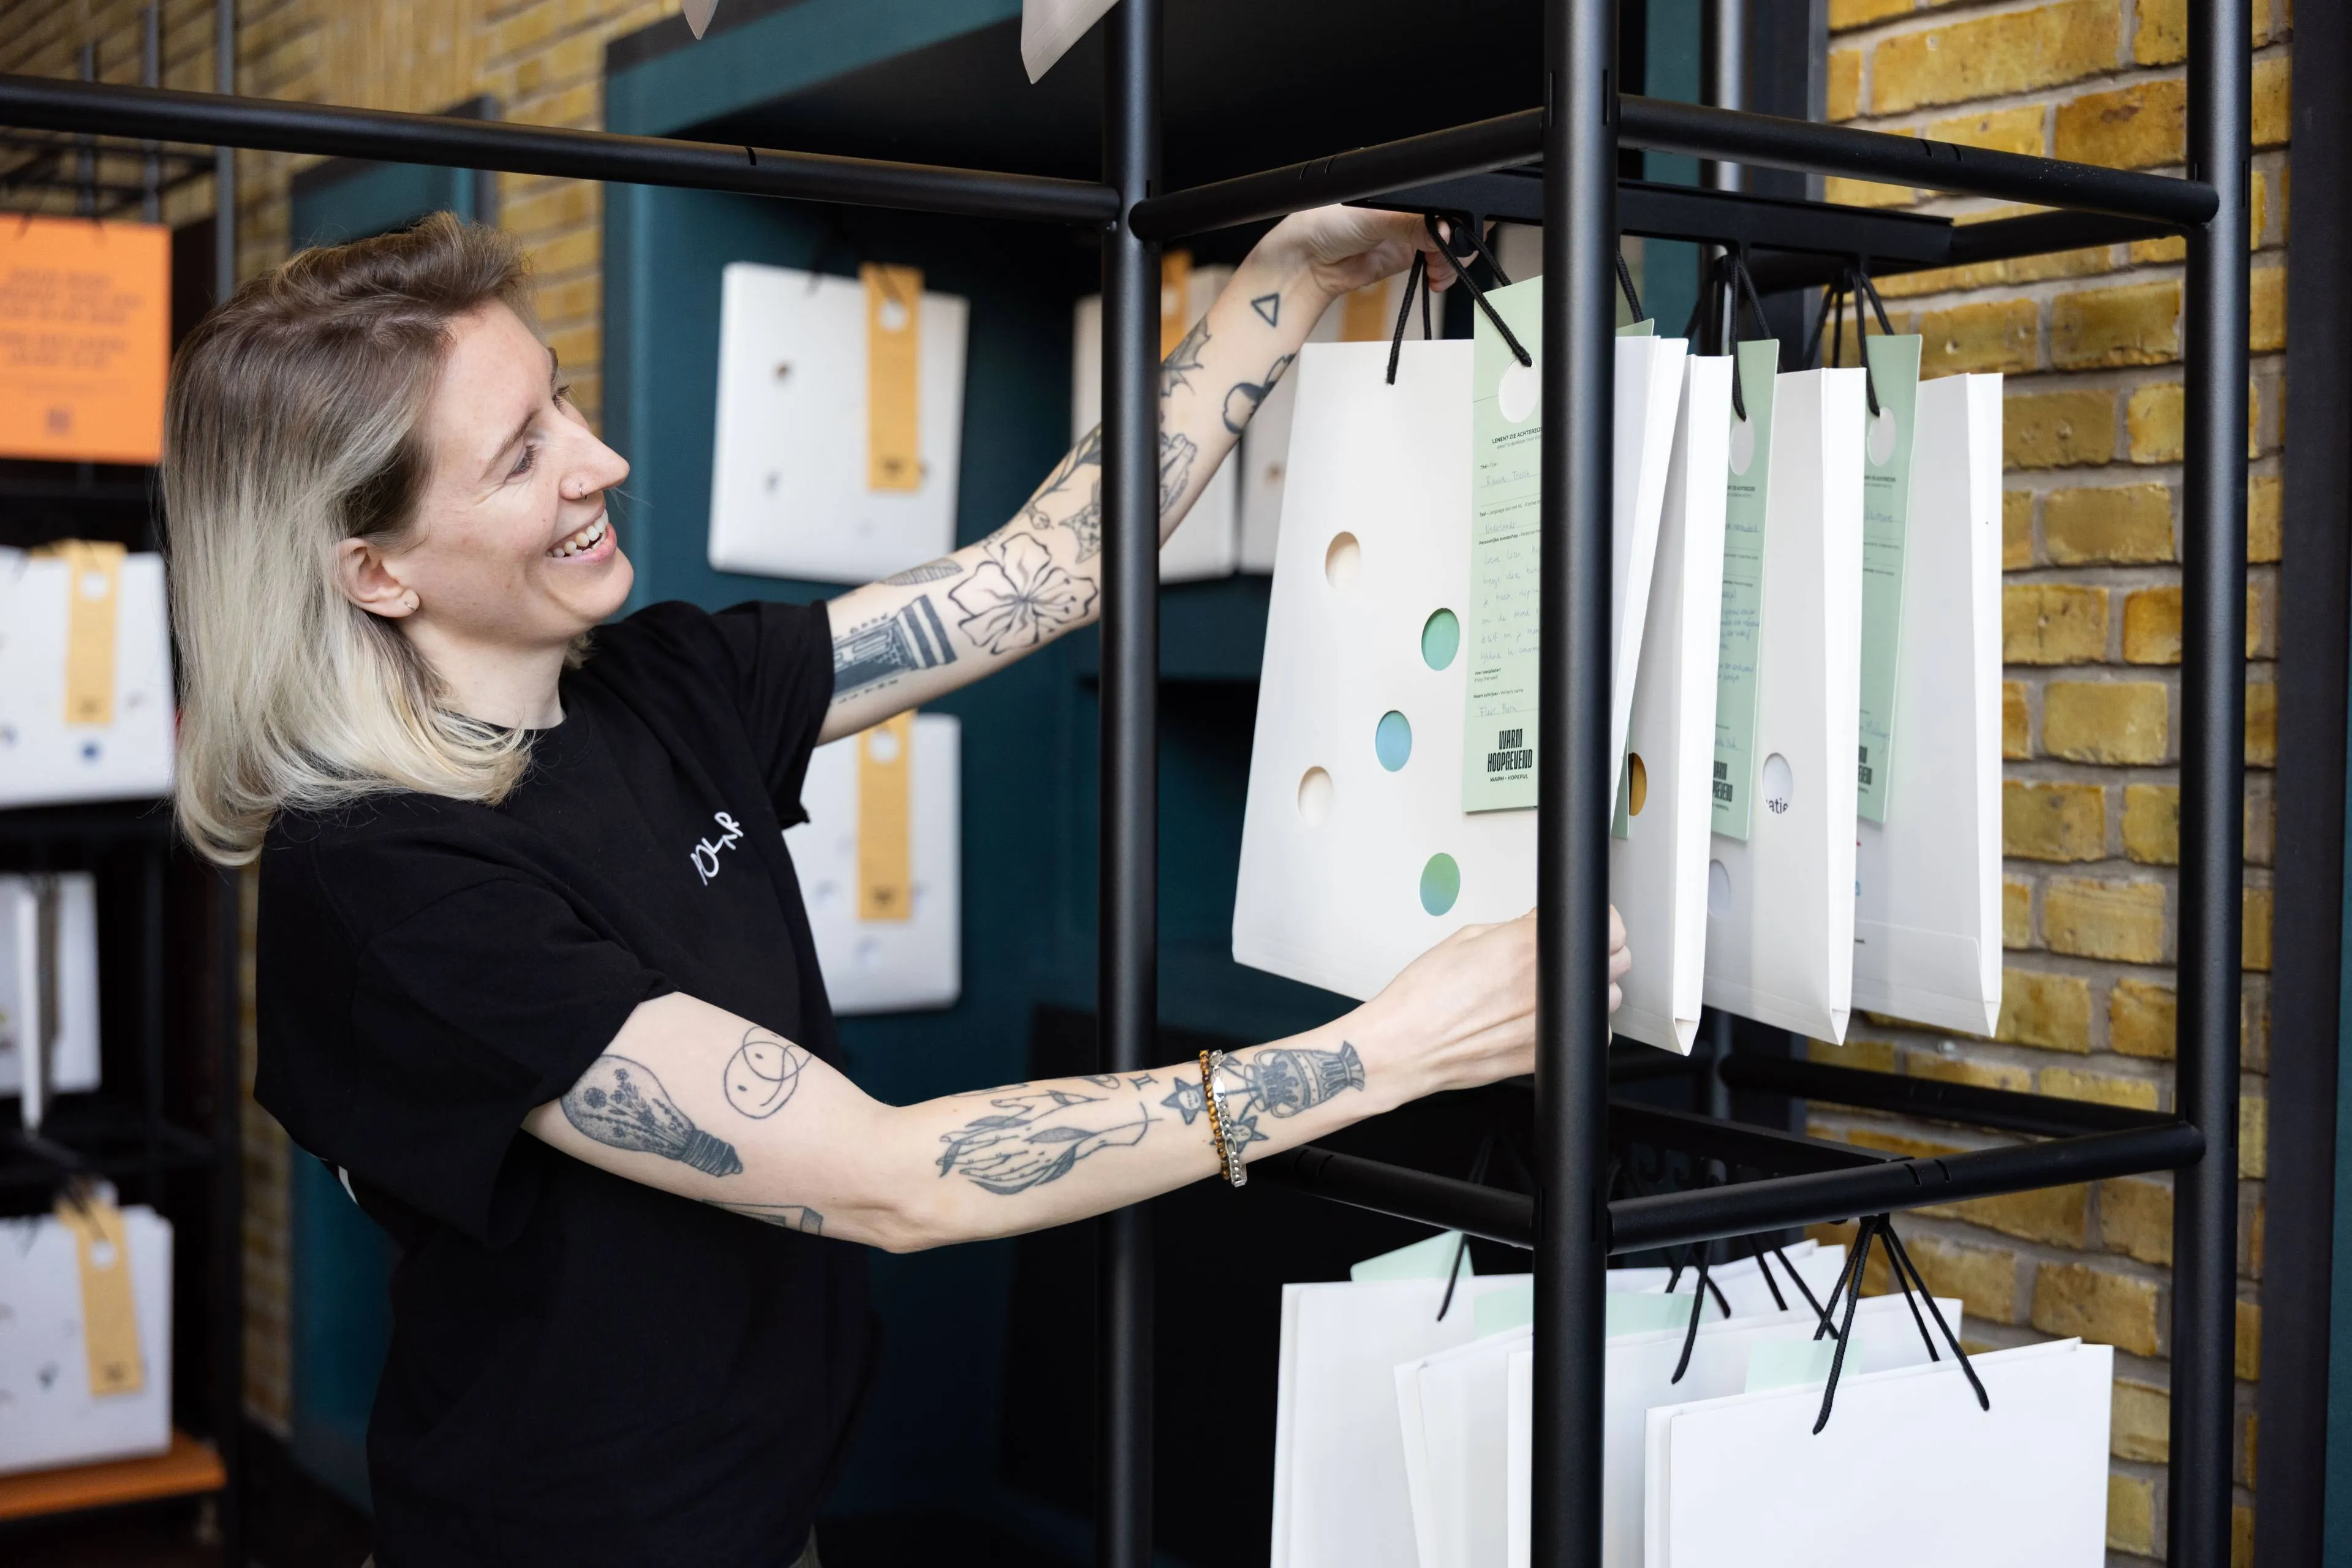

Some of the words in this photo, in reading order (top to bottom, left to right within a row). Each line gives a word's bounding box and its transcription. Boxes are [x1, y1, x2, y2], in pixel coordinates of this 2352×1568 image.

[1492, 435, 1508, 443] LENEN?
[1499, 728, 1523, 750] WARM
[1488, 748, 1533, 772] HOOPGEVEND
[1766, 797, 1788, 813] atie
